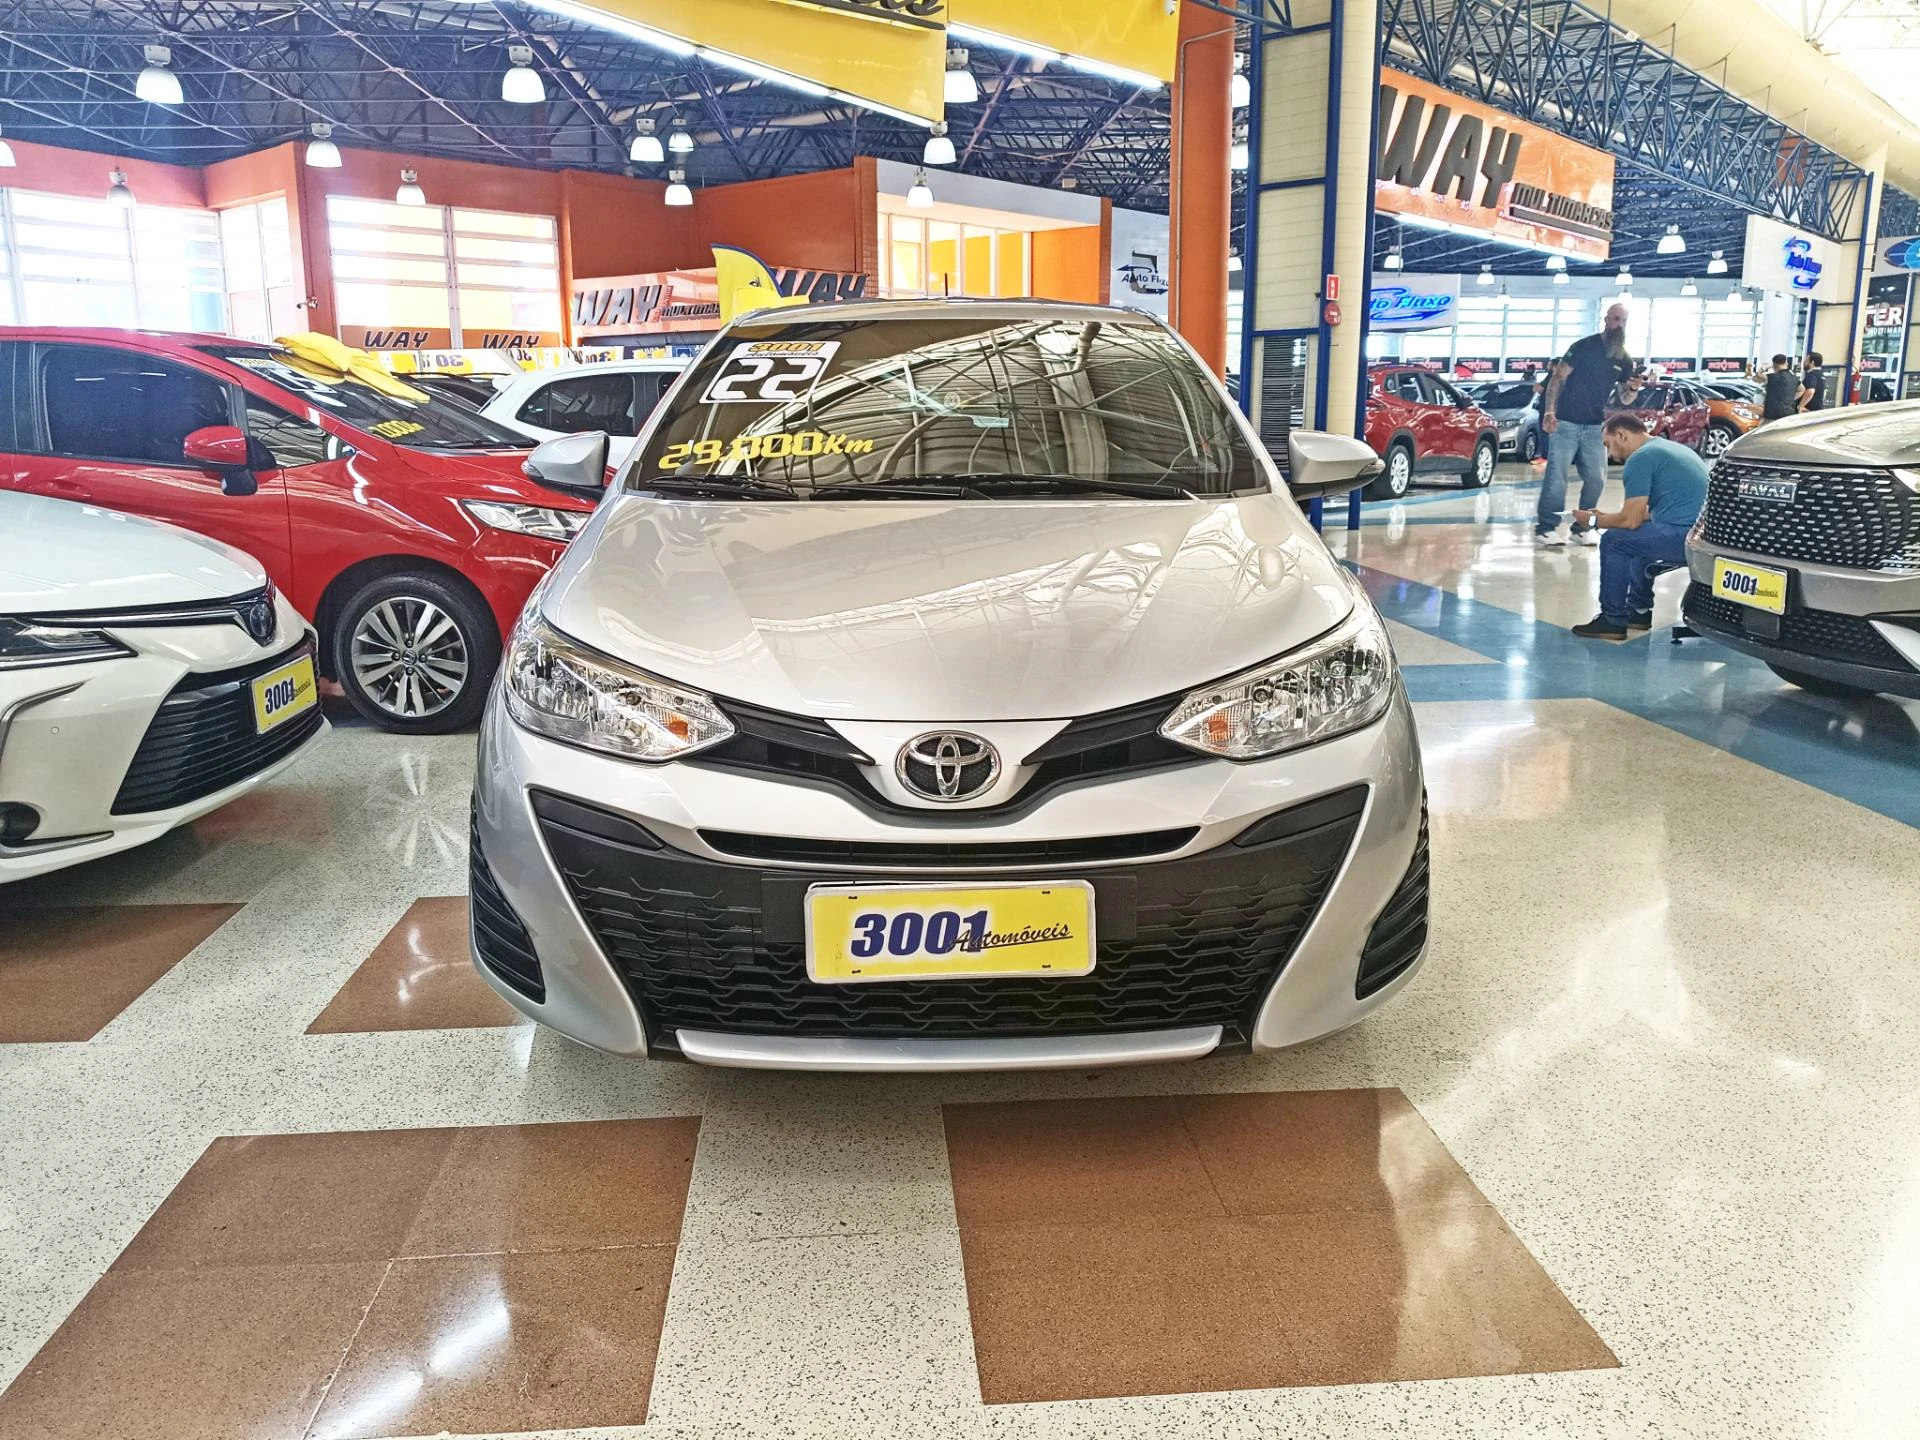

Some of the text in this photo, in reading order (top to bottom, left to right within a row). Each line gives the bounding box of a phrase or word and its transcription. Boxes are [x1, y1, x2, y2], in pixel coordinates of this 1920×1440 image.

[1377, 84, 1523, 208] WAY
[1510, 182, 1614, 230] MULTIMARCAS
[574, 284, 662, 326] WAY
[1394, 296, 1451, 309] Fluxo
[364, 330, 430, 348] WAY
[483, 333, 540, 349] WAY
[748, 342, 826, 352] 3001
[711, 358, 823, 400] 22
[1739, 480, 1791, 499] HAVAL
[1722, 570, 1758, 596] 3001
[264, 676, 295, 714] 3001
[850, 910, 1071, 958] 3001 Automóveis
